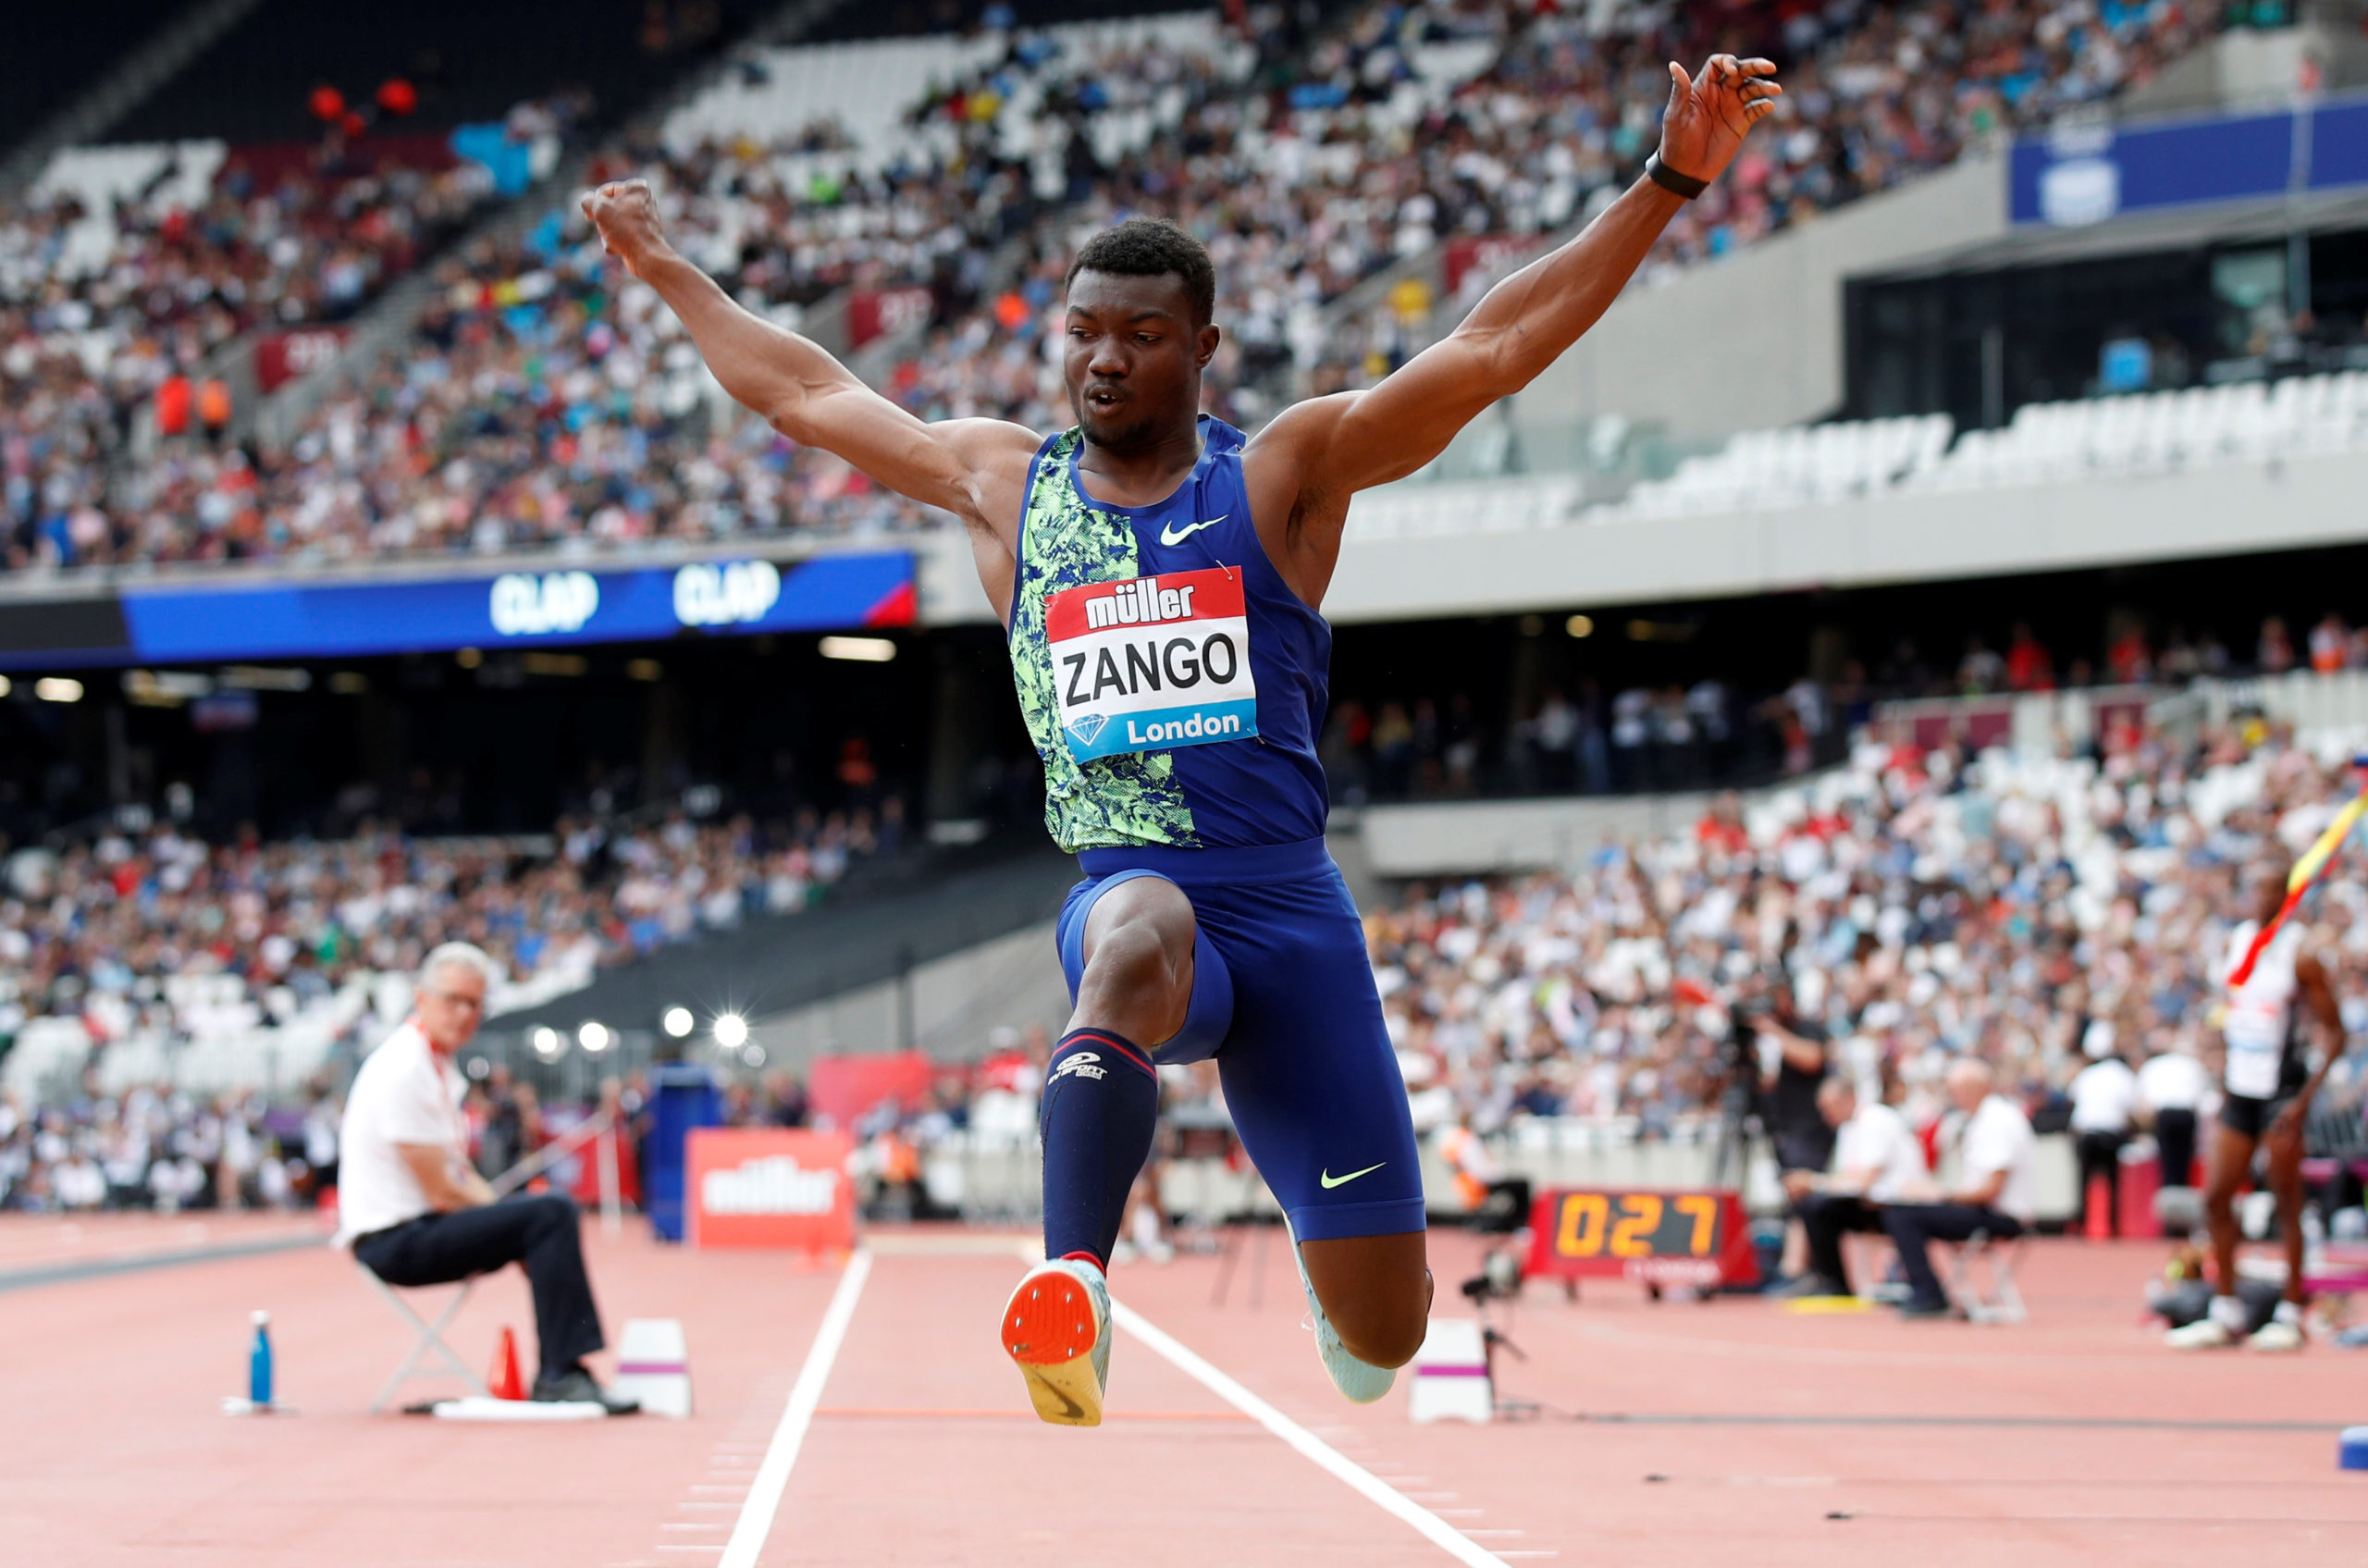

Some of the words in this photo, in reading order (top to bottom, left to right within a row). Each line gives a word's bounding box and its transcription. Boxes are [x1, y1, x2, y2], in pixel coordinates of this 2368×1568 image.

[1085, 578, 1195, 630] müller
[1063, 633, 1238, 707] ZANGO
[1127, 712, 1240, 745] London
